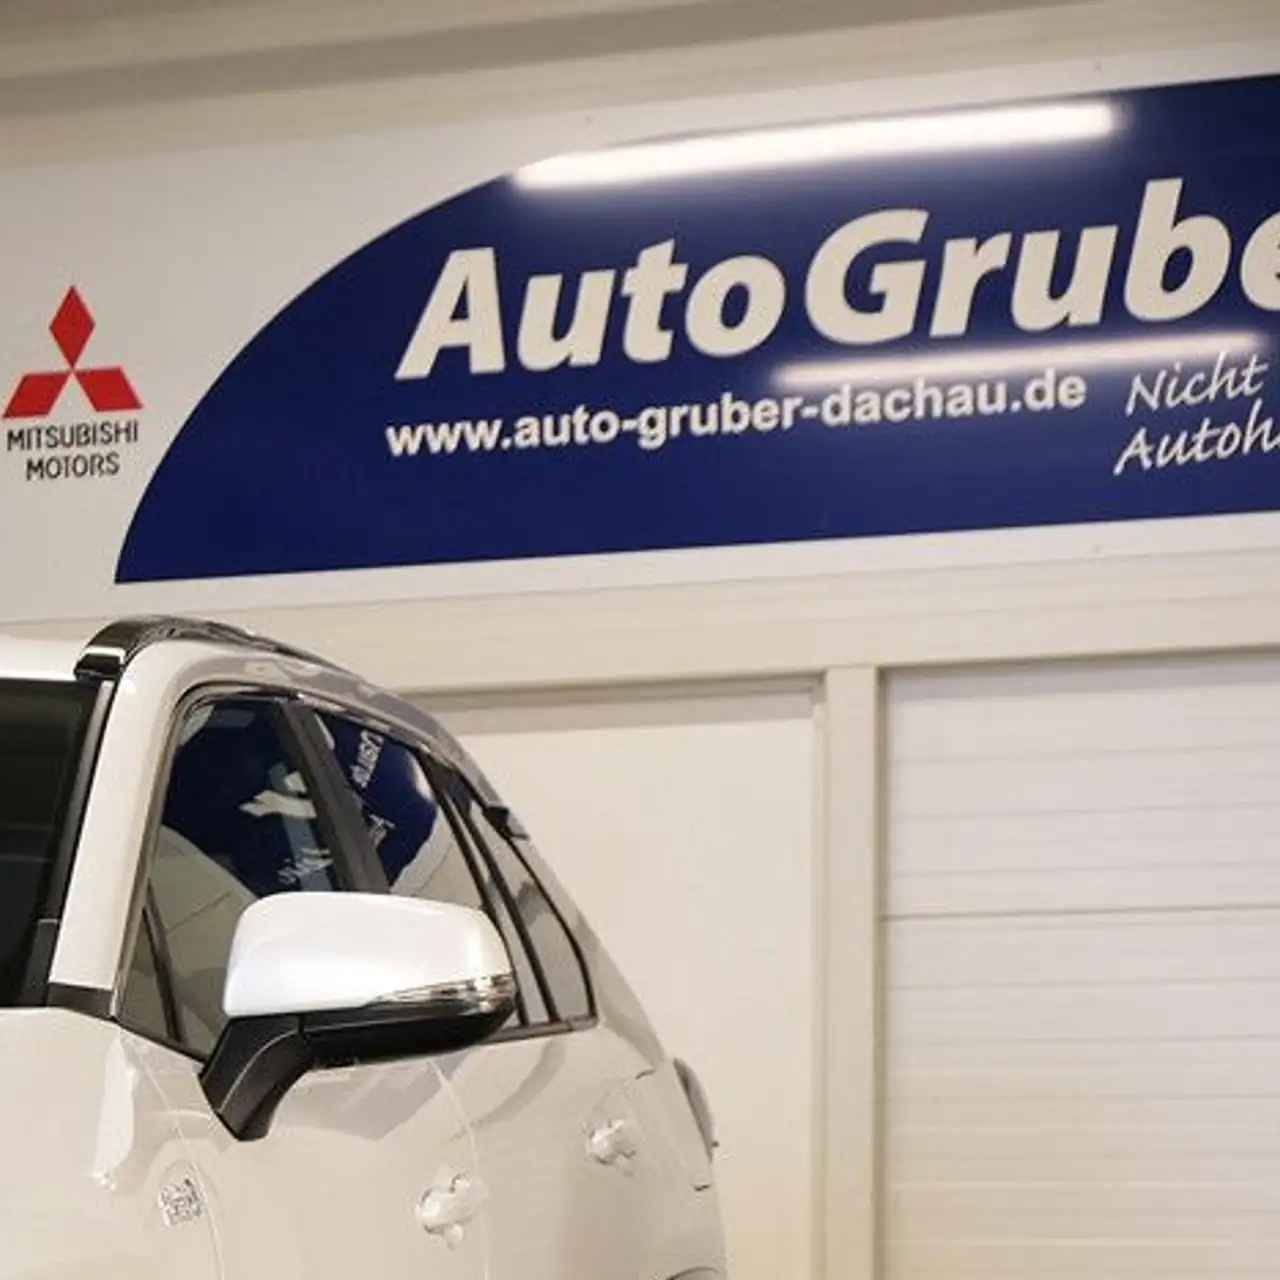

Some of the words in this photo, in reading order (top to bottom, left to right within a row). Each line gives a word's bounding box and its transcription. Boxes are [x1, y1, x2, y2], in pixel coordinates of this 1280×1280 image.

[386, 368, 1088, 457] www.auto-gruber-dachau.de
[1126, 351, 1269, 416] Nicht
[6, 419, 140, 452] MITSUBISHI
[26, 453, 121, 480] MOTORS
[1112, 399, 1280, 476] Autoh
